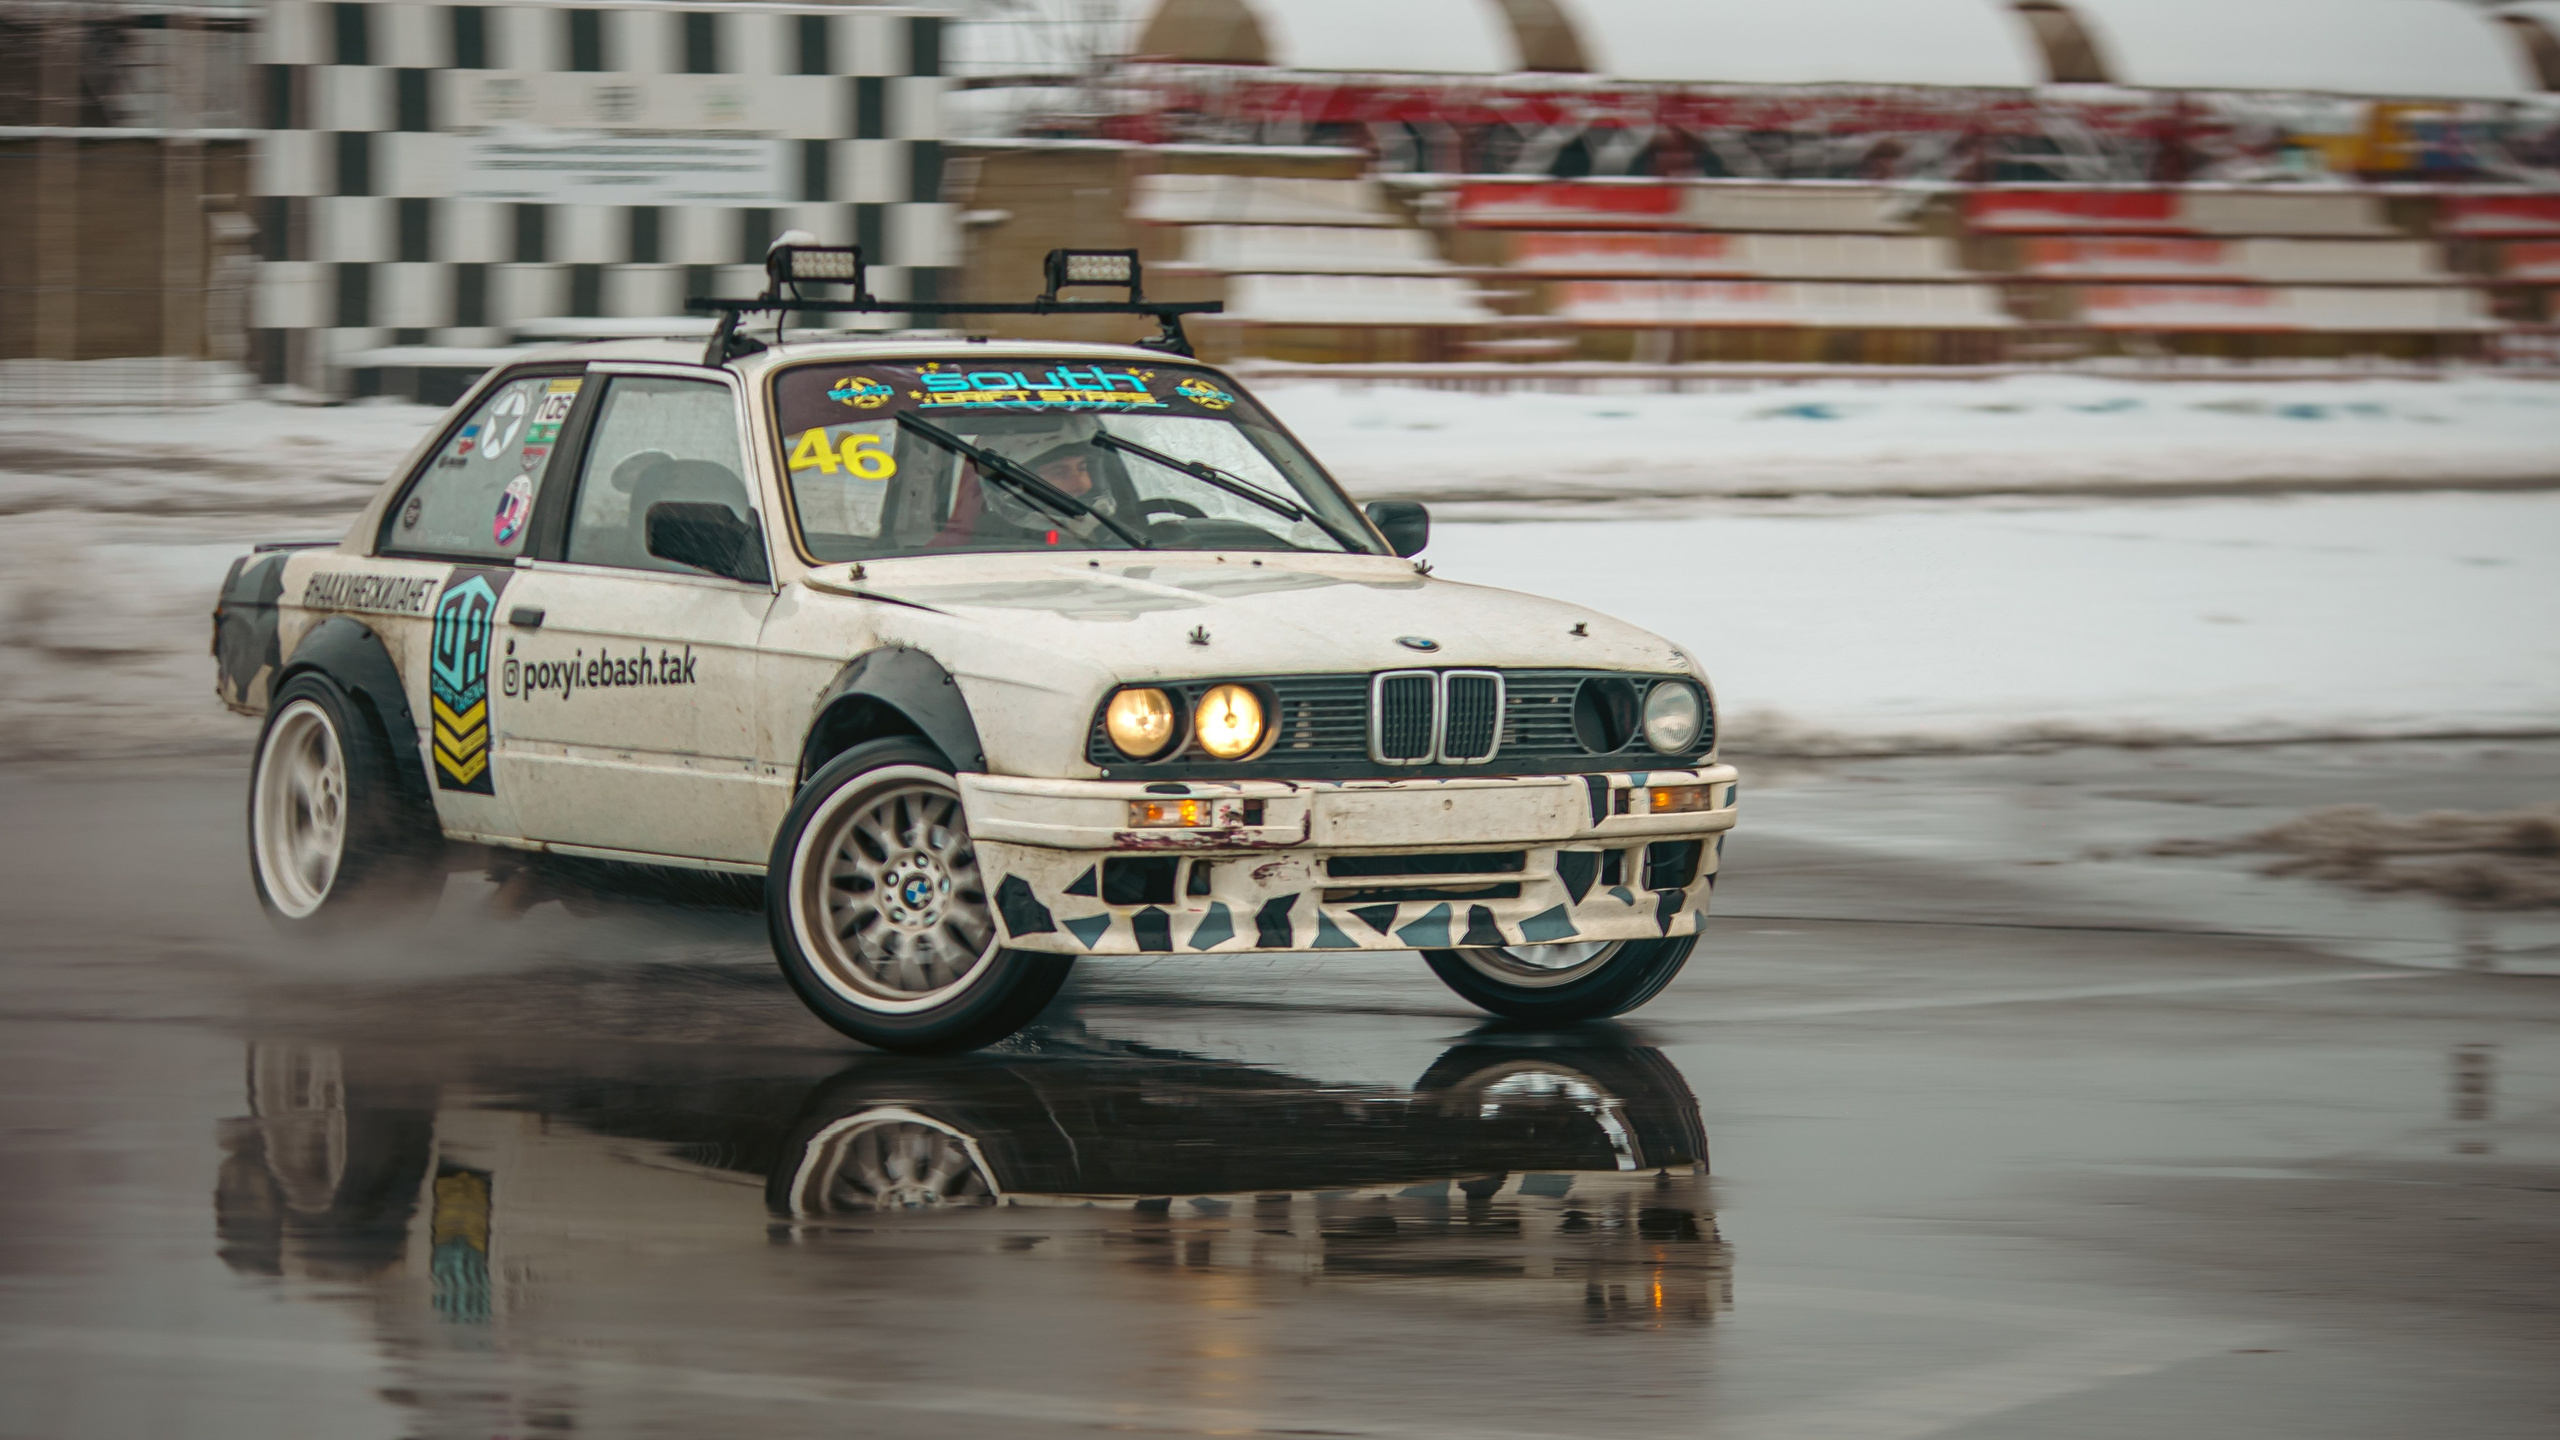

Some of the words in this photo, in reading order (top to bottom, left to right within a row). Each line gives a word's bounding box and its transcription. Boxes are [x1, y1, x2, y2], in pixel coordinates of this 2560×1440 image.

[932, 390, 1032, 403] DRIFT
[1037, 390, 1157, 404] STARS
[787, 426, 898, 480] 46
[523, 644, 697, 701] poxyi.ebash.tak
